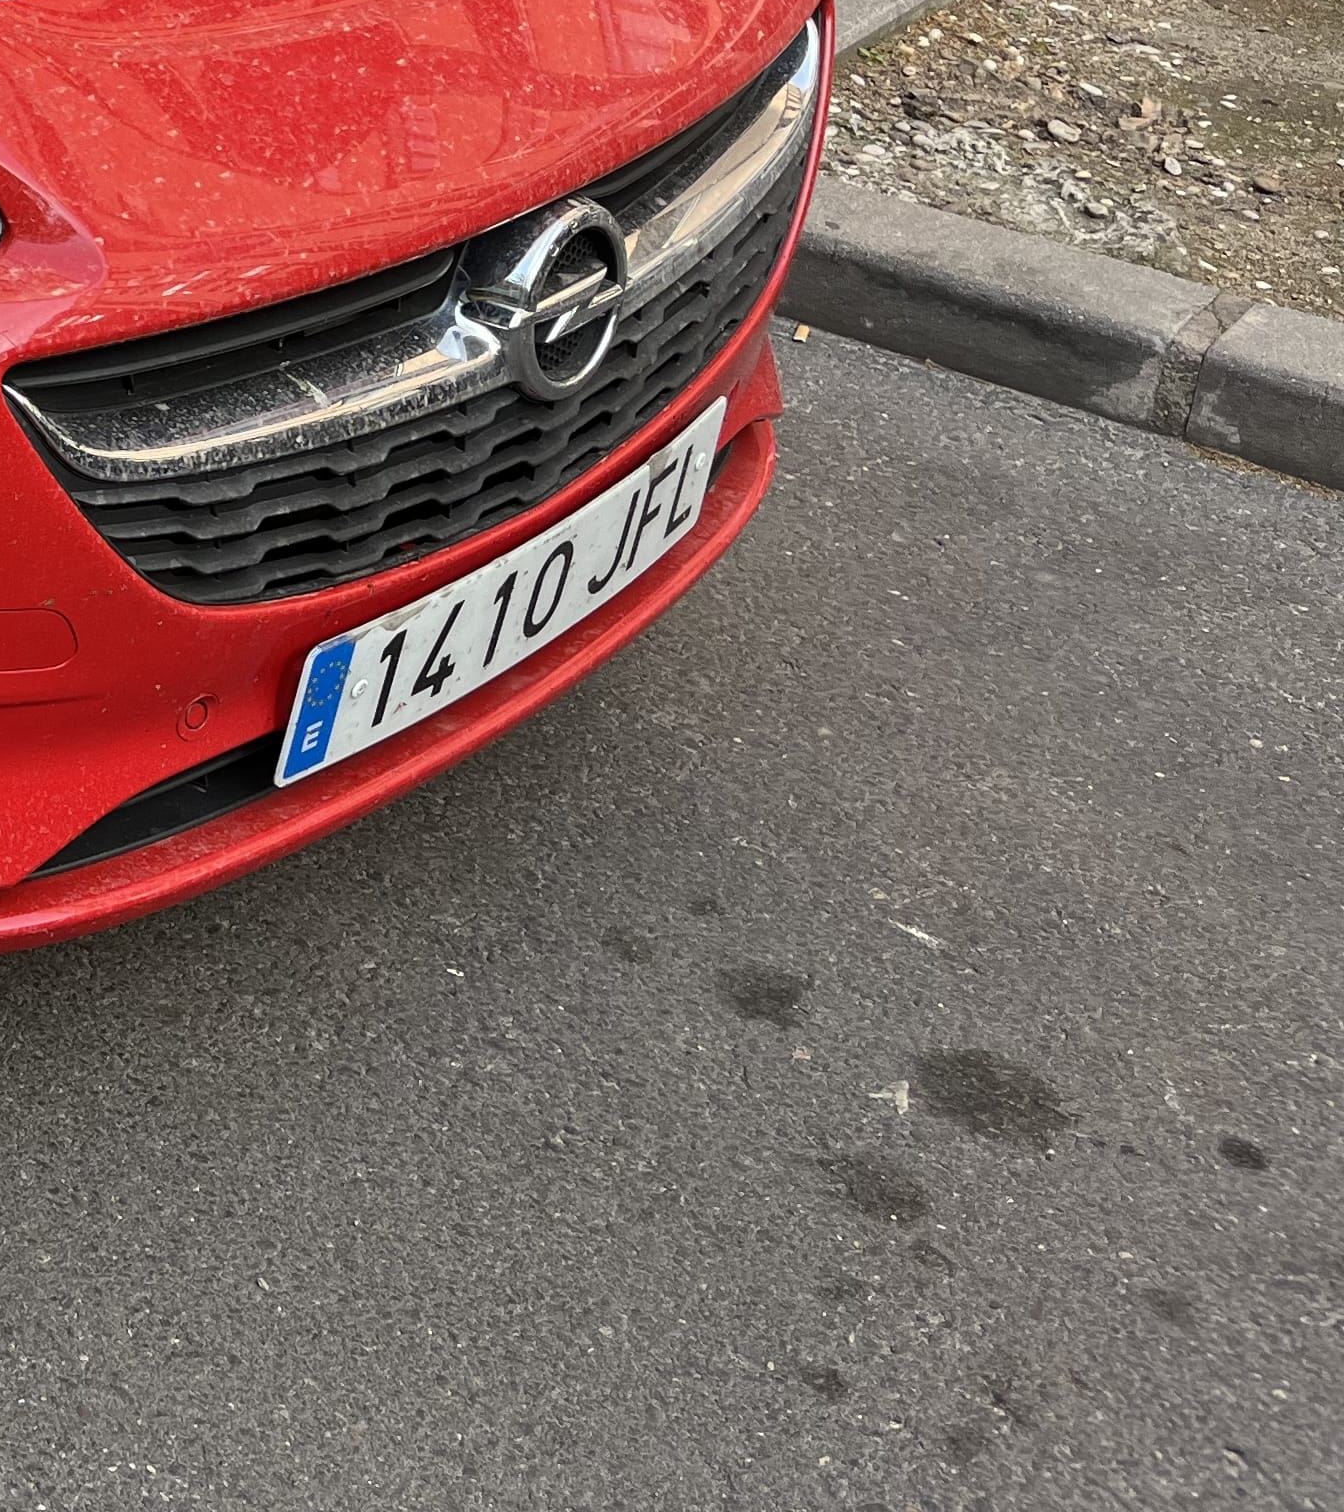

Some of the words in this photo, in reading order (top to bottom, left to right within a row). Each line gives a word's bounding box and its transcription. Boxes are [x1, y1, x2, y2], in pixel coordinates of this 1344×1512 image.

[371, 539, 574, 729] 1410
[587, 443, 693, 596] JFL
[300, 719, 324, 754] E
